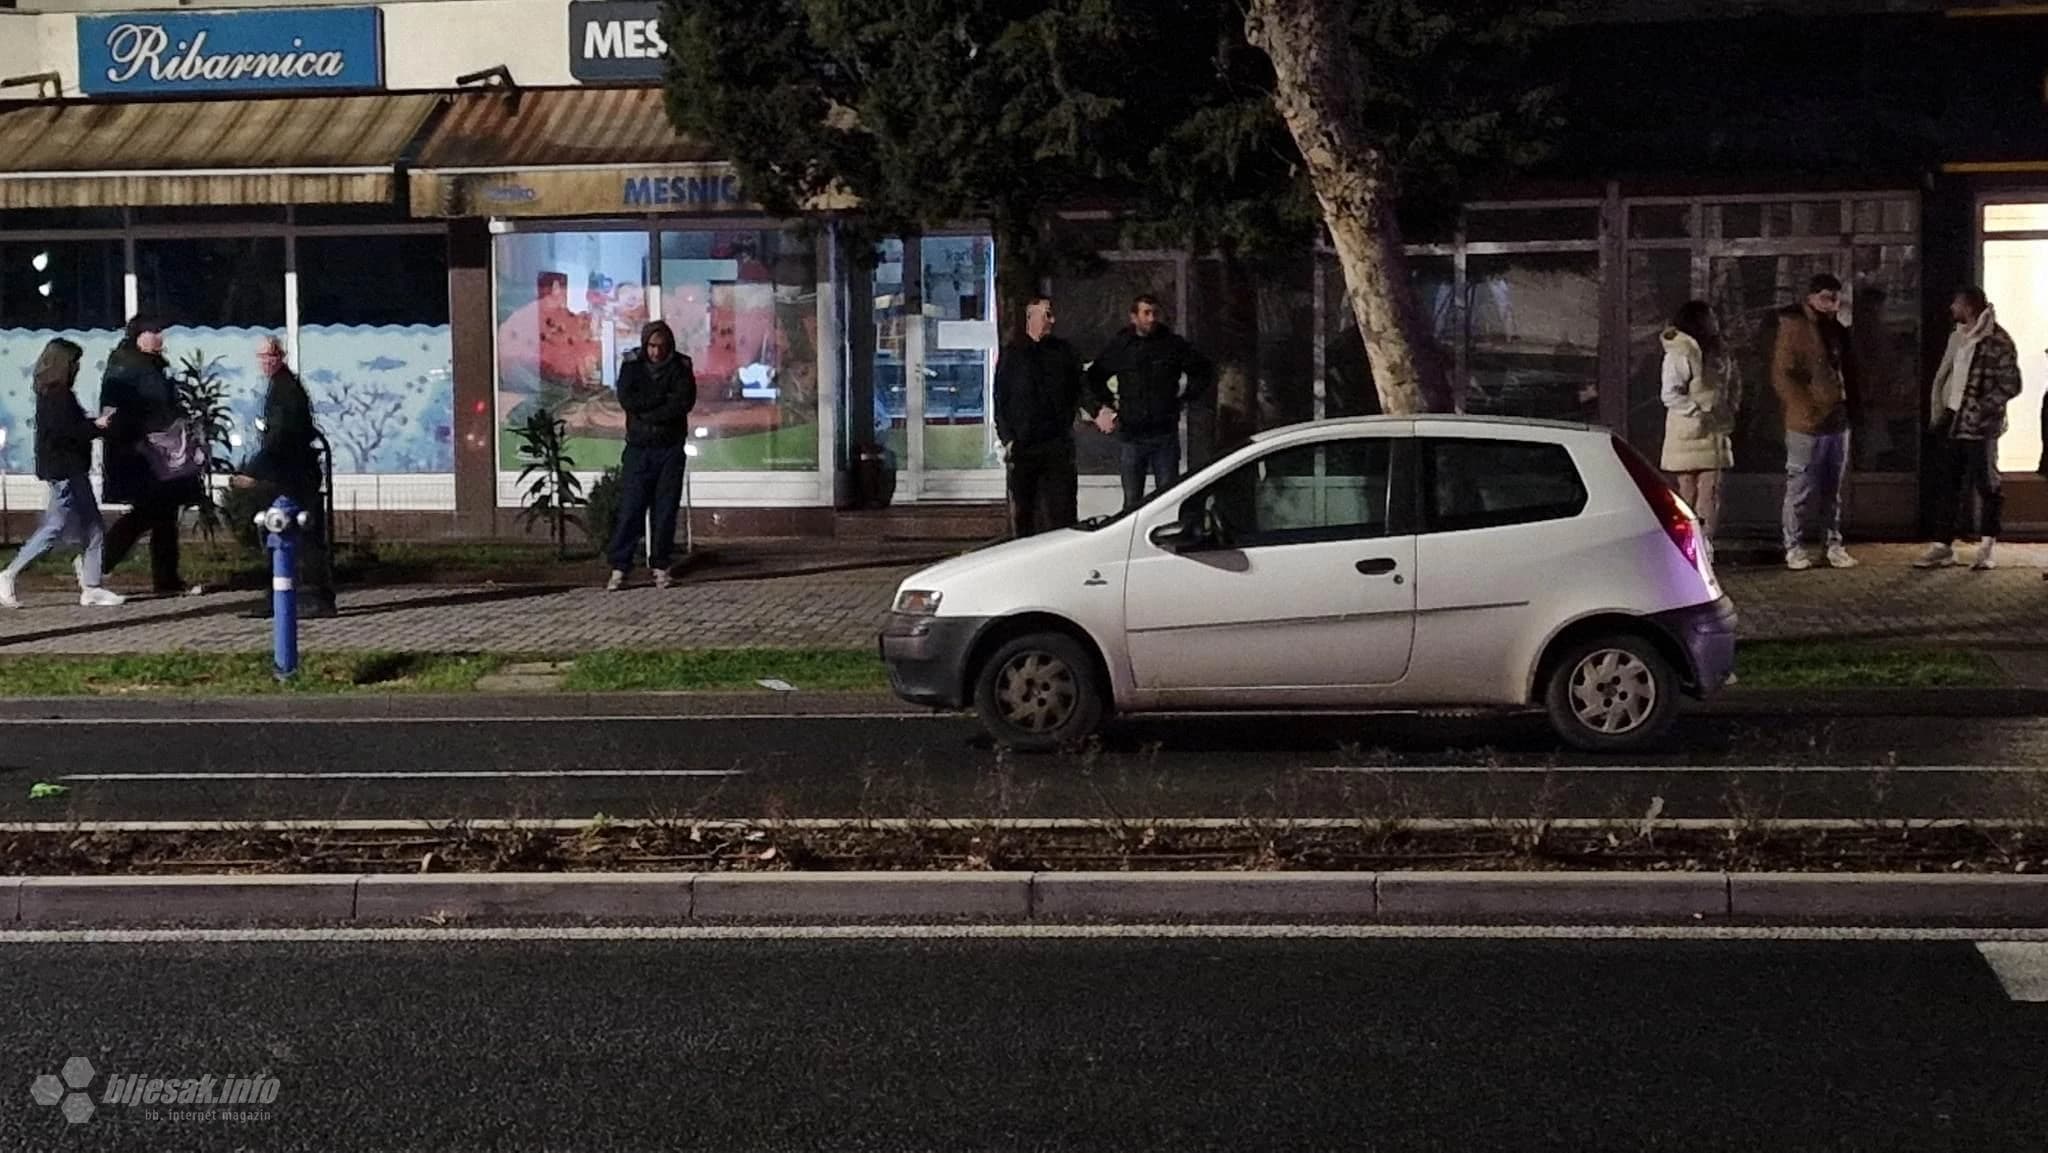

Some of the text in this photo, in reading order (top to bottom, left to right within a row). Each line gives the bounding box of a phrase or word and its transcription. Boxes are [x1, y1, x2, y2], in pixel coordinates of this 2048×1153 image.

[106, 23, 344, 82] Ribarnica
[584, 19, 669, 59] MES
[623, 175, 739, 205] MESNIC
